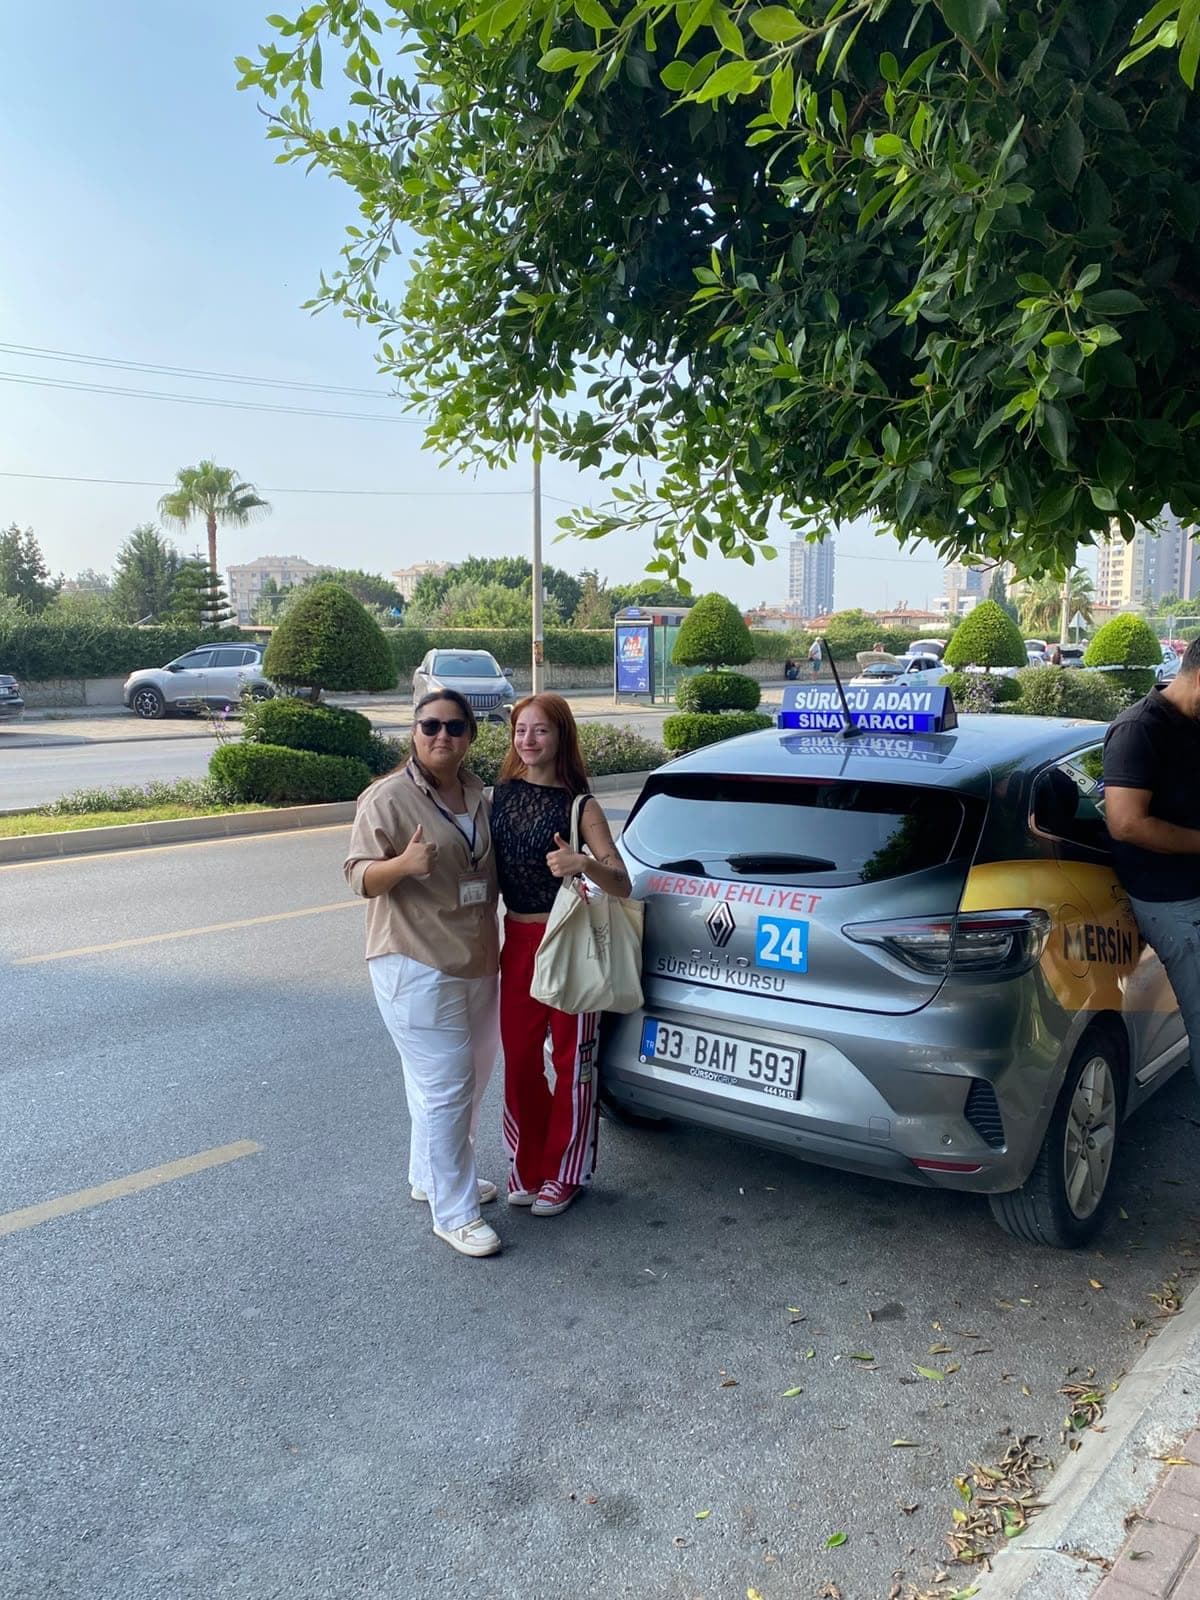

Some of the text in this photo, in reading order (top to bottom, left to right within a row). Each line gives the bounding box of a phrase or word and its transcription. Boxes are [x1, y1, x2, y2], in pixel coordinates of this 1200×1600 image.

[872, 692, 932, 711] ADAYI
[856, 715, 914, 730] ARACI
[760, 923, 803, 965] 24
[691, 949, 750, 968] CLIO
[657, 956, 785, 992] SÜRÜCÜ KURSU
[646, 1040, 655, 1049] TR
[656, 1027, 794, 1086] 33 BAM 593
